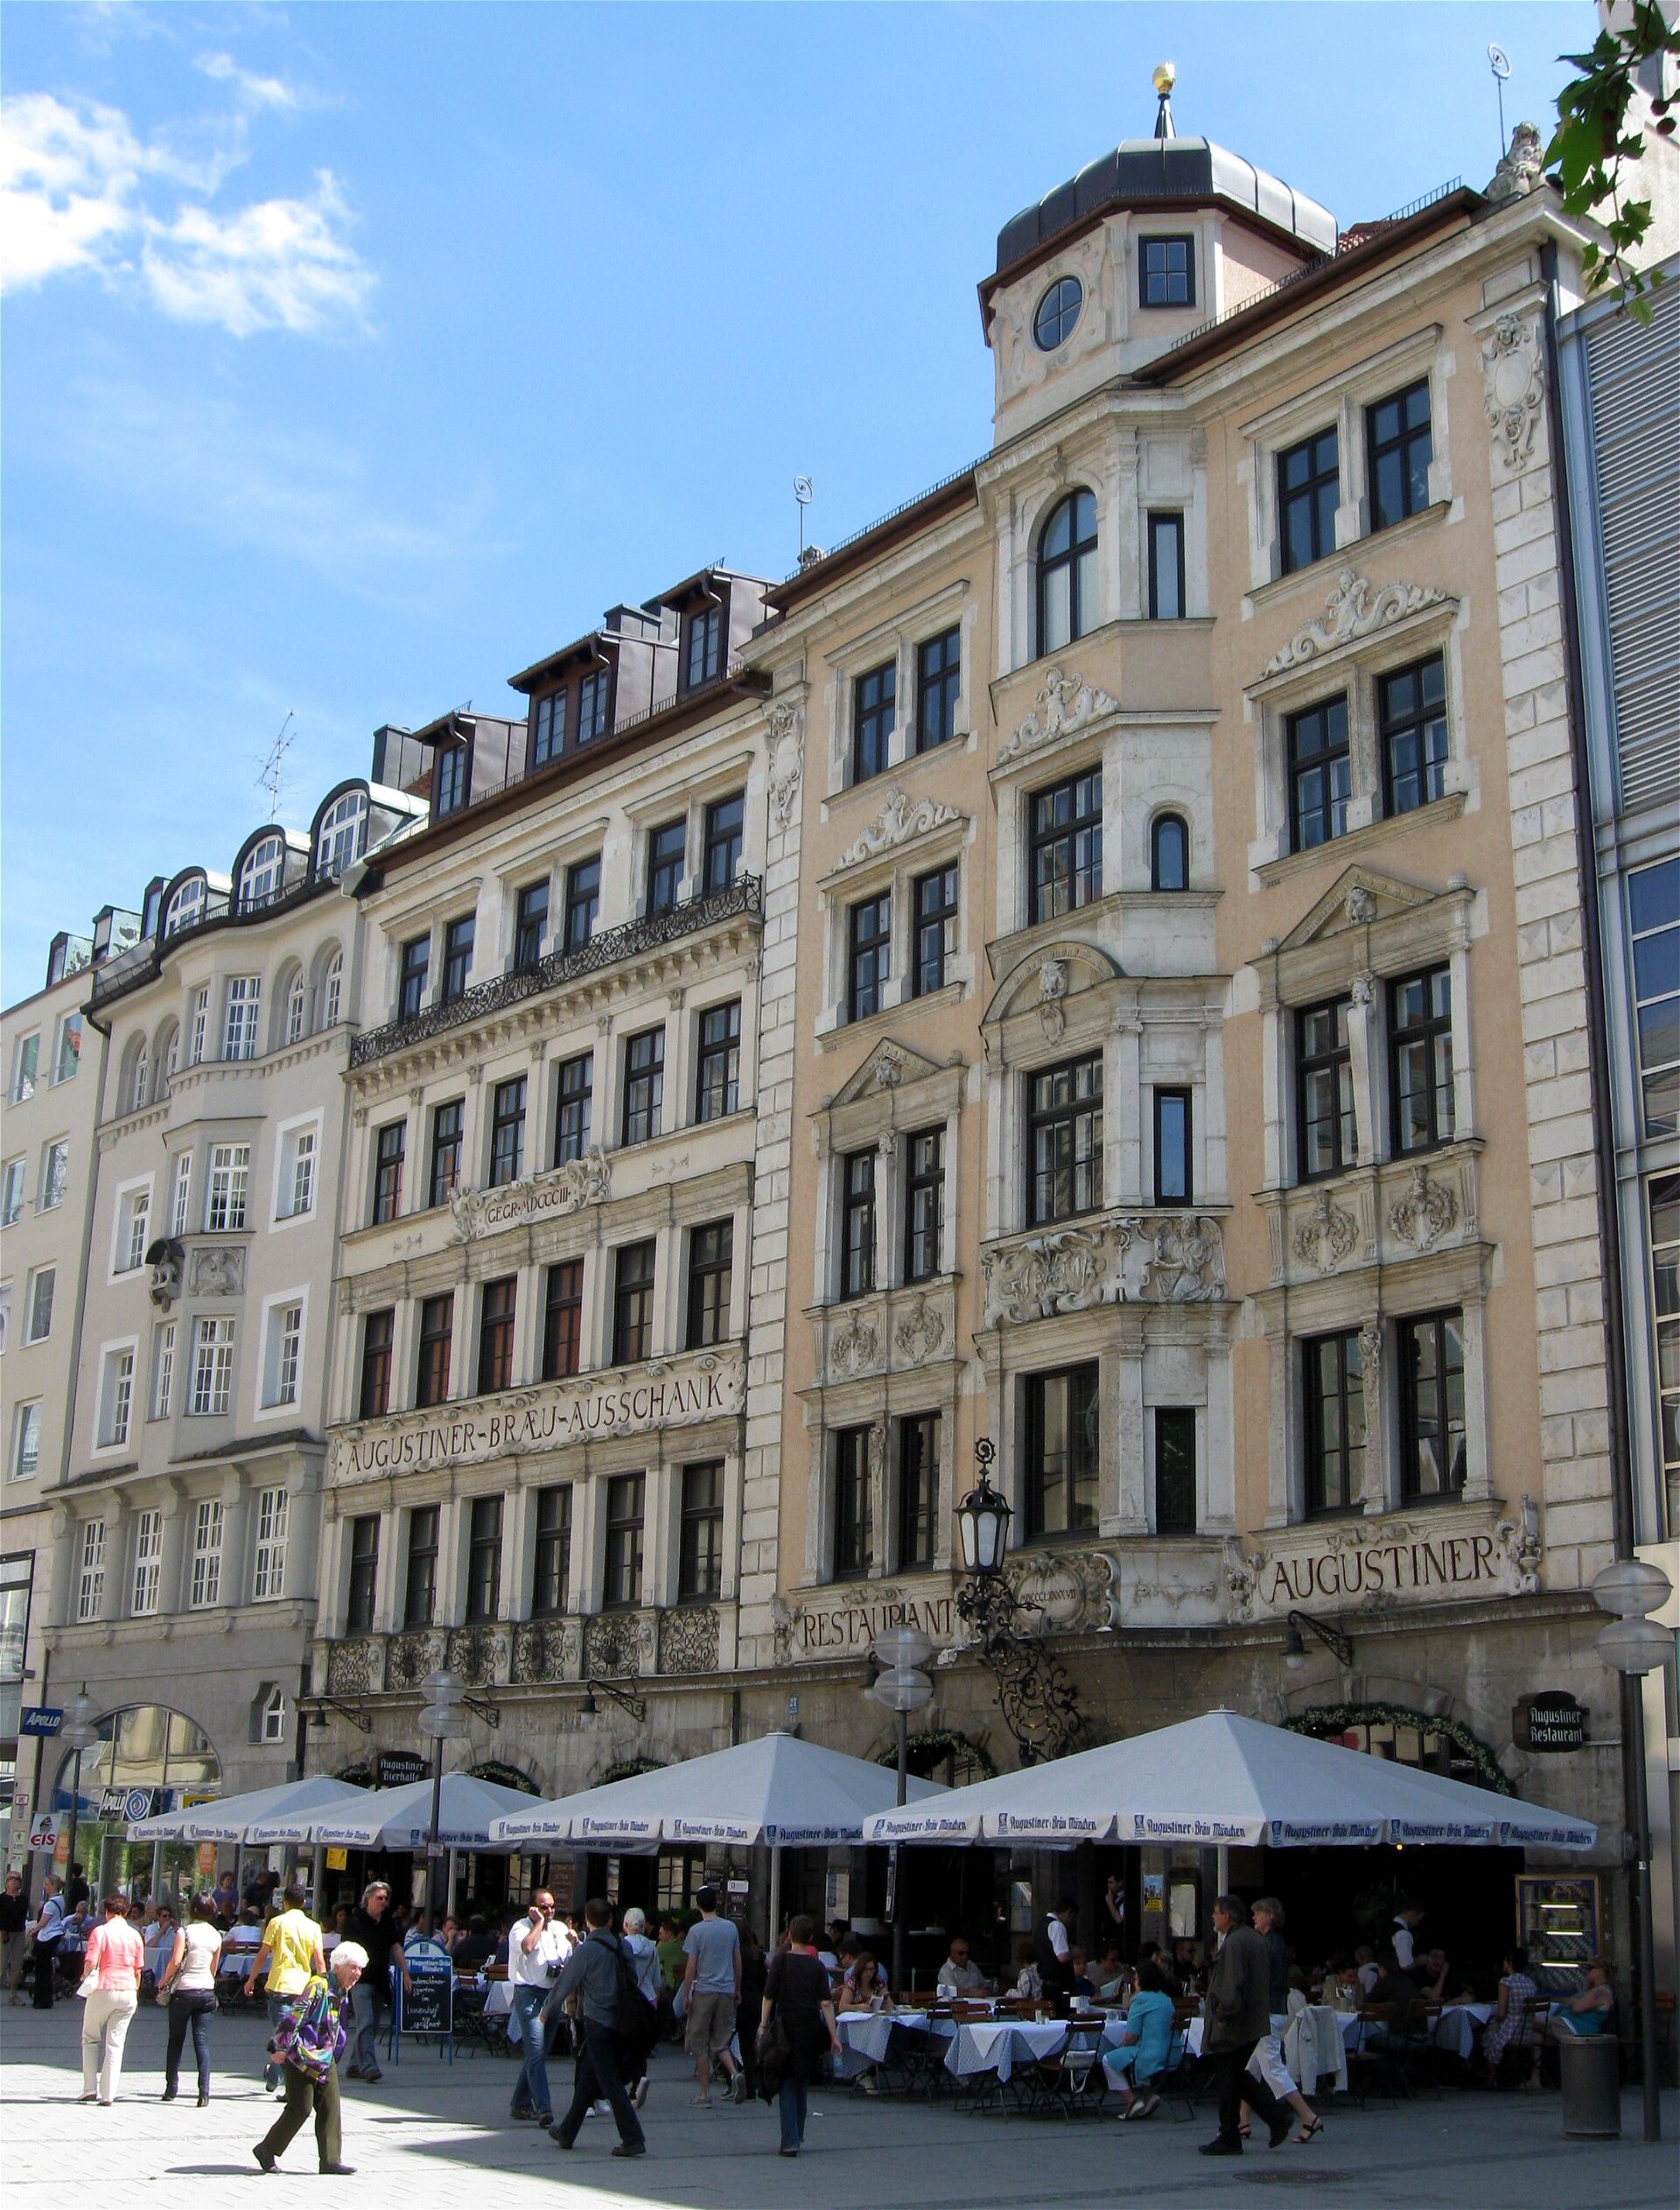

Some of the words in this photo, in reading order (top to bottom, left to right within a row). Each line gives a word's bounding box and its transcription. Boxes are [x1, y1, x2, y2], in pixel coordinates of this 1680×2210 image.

[1270, 1535, 1497, 1603] AUGUSTINER
[1530, 1707, 1581, 1726] Augustiner
[1530, 1726, 1583, 1742] Restaurant
[380, 1759, 424, 1771] Augustiner
[383, 1770, 420, 1782] Bierhalle
